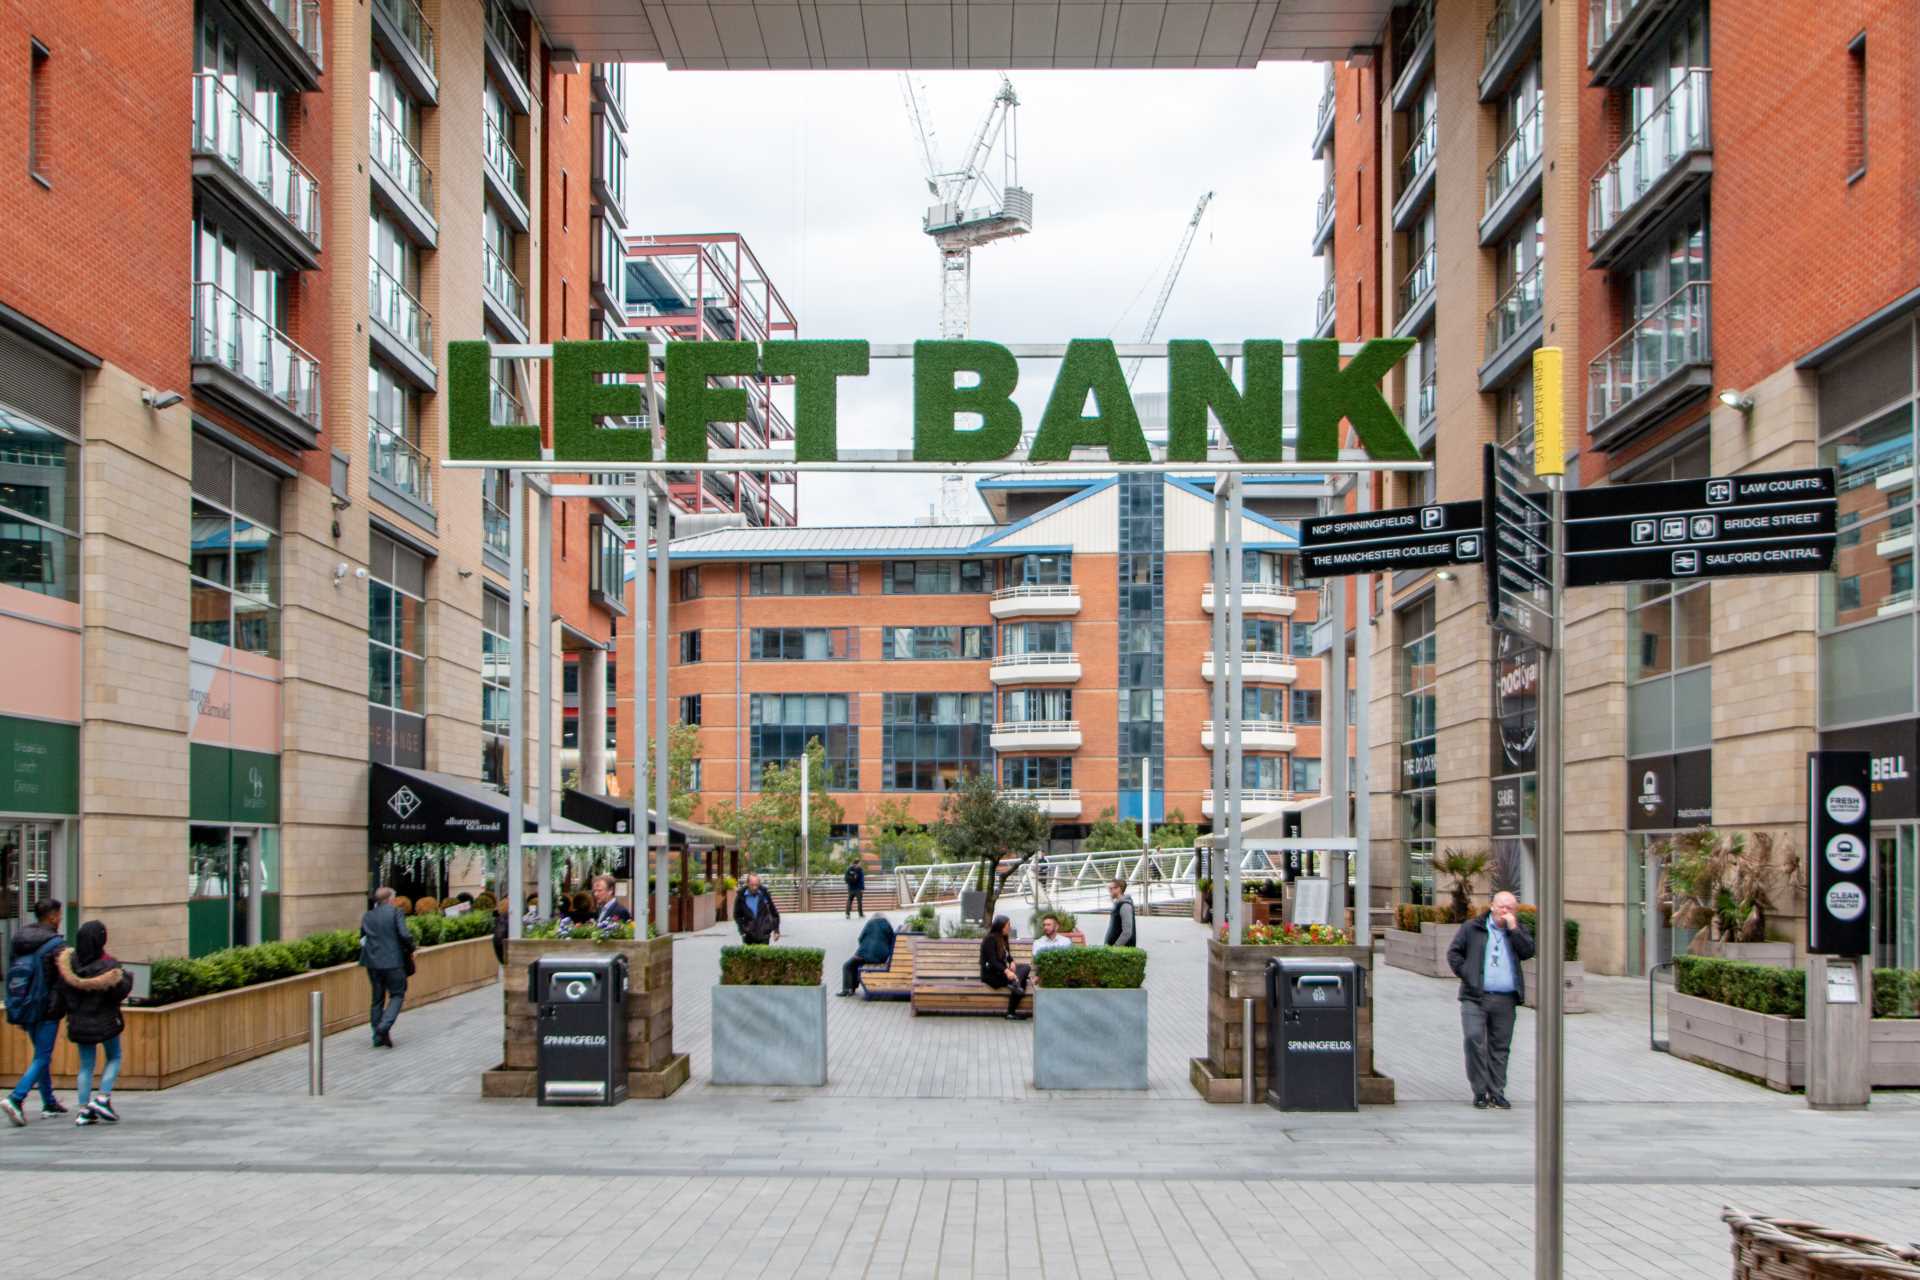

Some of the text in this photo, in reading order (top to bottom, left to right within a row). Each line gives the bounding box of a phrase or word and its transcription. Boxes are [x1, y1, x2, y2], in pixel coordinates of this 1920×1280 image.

[448, 340, 870, 461] LEFT
[914, 339, 1420, 462] BANK
[1740, 477, 1820, 494] LAW COURTS
[1312, 515, 1416, 535] NCP SPINNINGFIELDS
[1724, 512, 1820, 530] BRIDGE STREET
[1313, 543, 1450, 566] THE MANCHESTER COLLEGE
[1705, 547, 1821, 565] SALFORD CENTRAL
[1403, 759, 1414, 776] THE
[1872, 757, 1909, 780] BELL
[399, 823, 427, 831] RANGE
[543, 1035, 606, 1046] SPINNINGFIELDS
[1287, 1040, 1352, 1051] SPINNINGFIELDS
